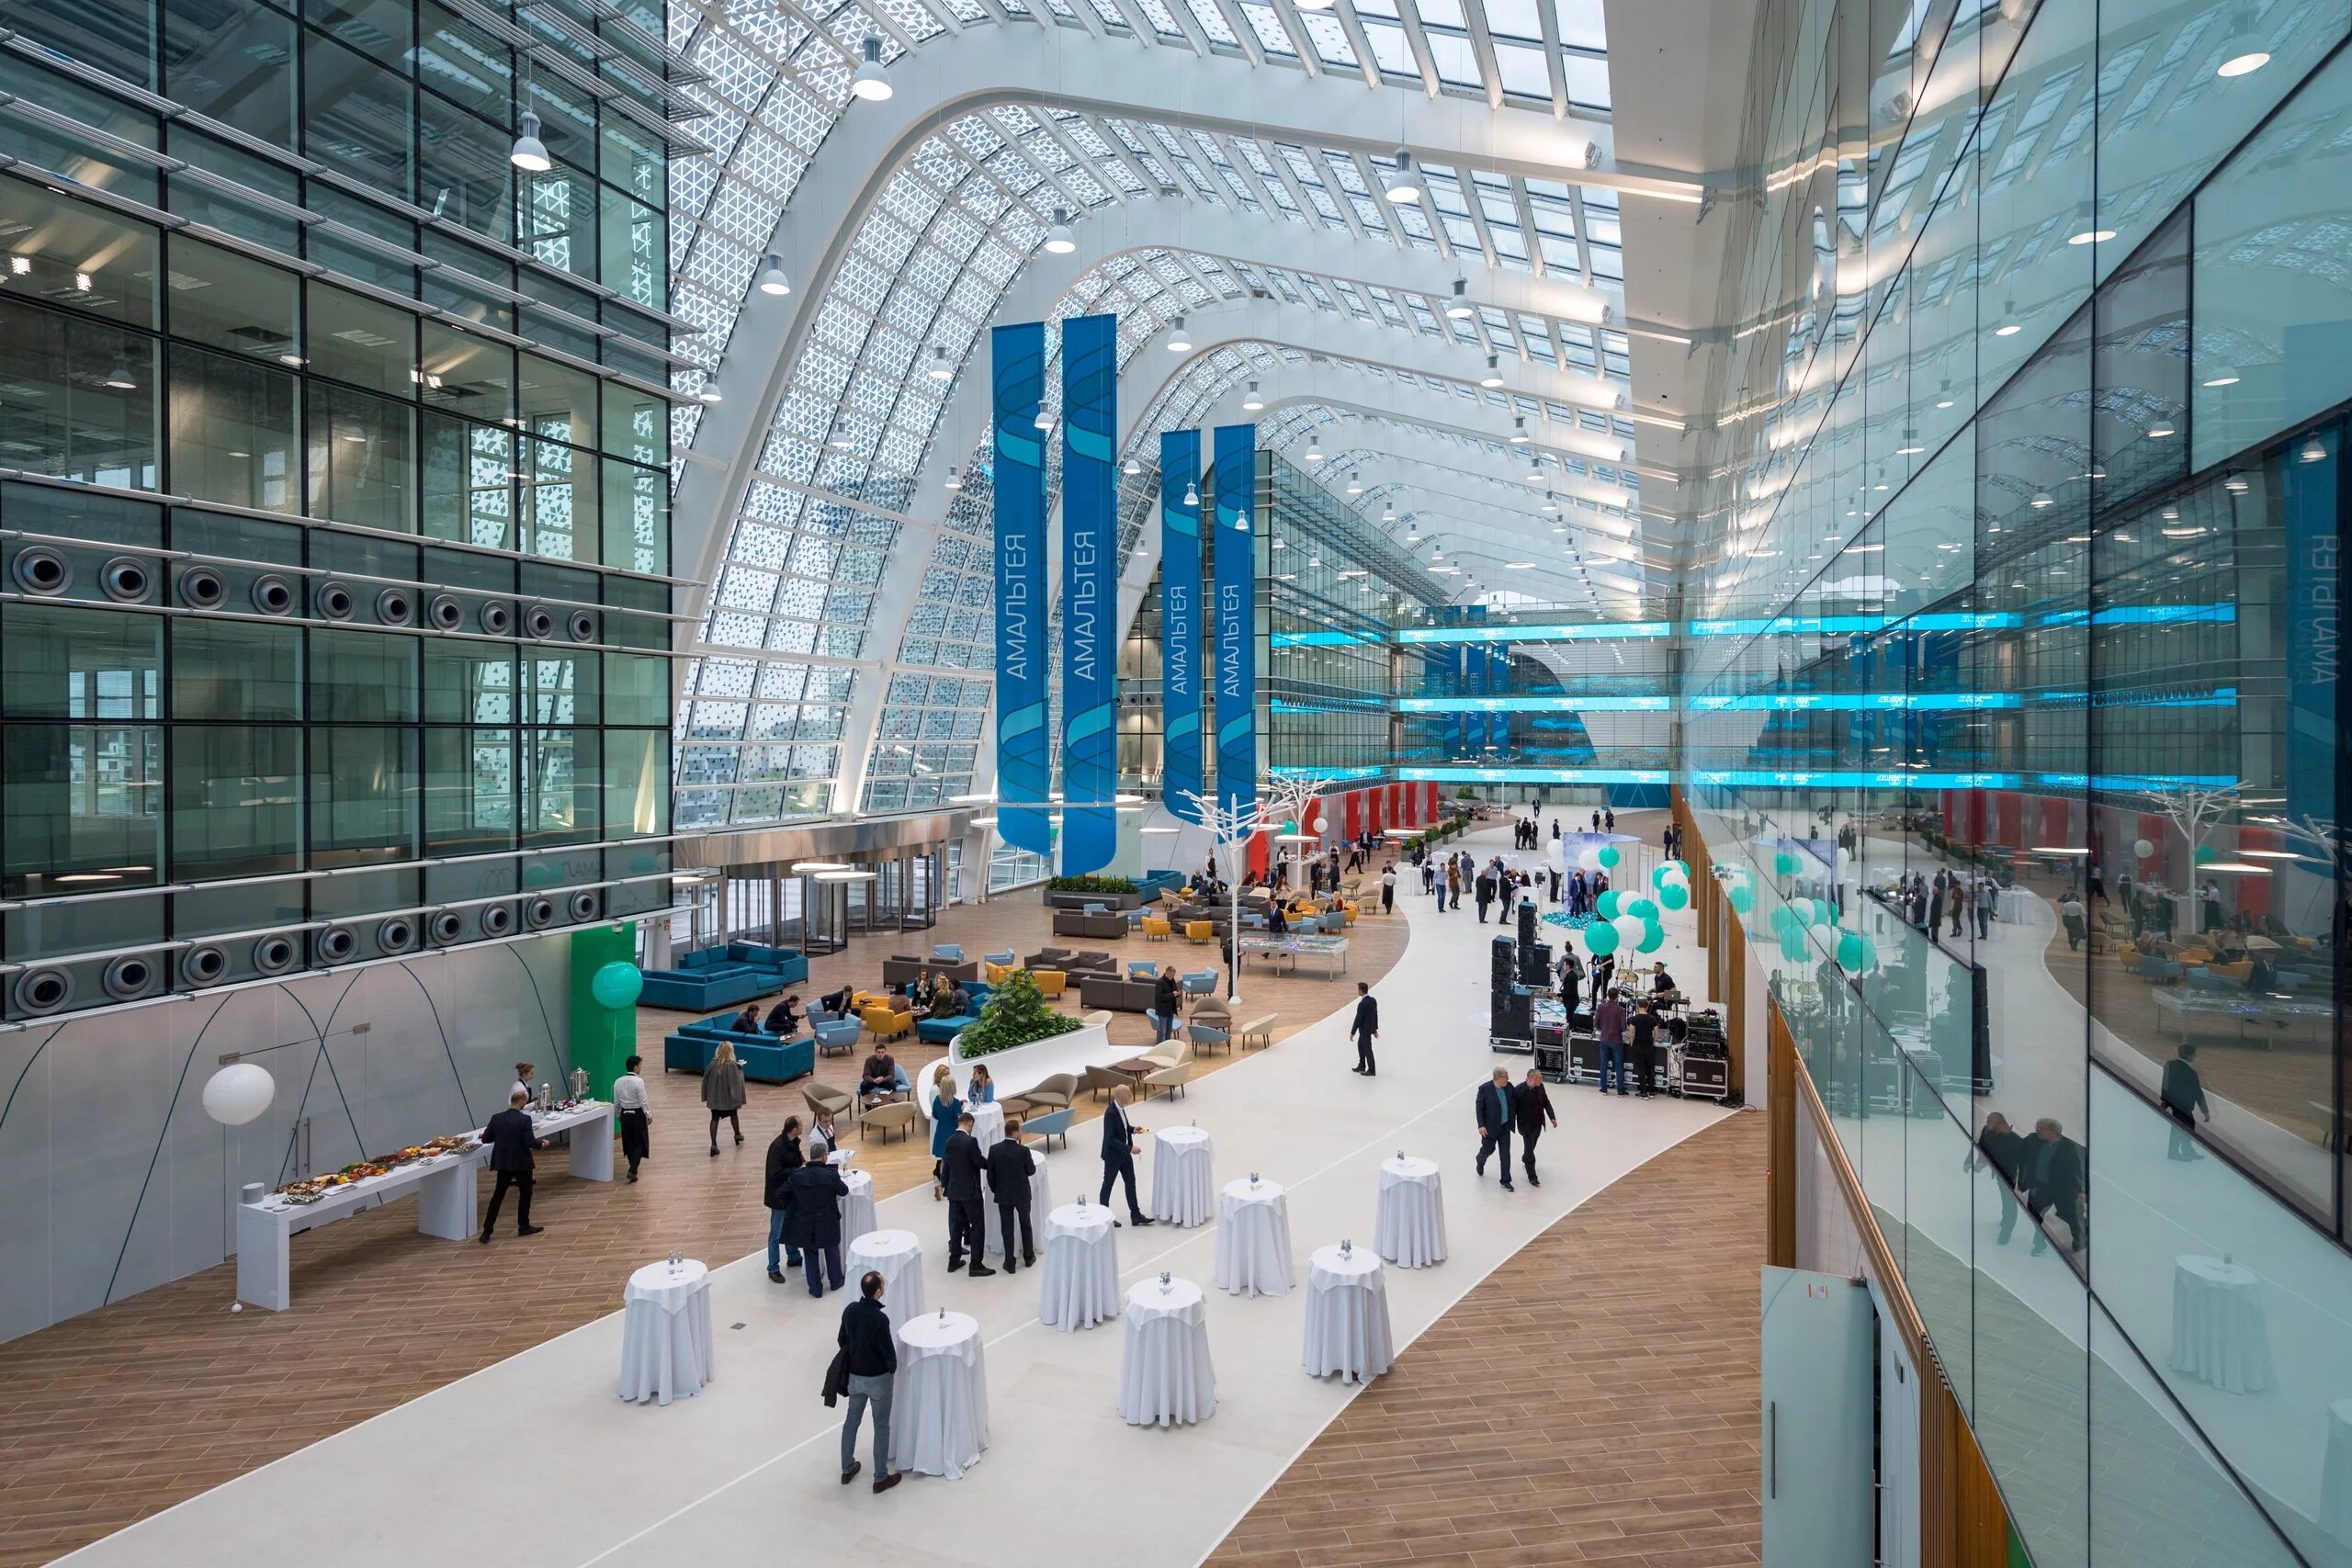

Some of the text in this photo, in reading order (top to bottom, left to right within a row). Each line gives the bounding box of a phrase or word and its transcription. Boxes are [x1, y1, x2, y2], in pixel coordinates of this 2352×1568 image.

[1005, 535, 1027, 681] АМАЛЬТЕЯ
[1074, 531, 1095, 681] АМАЛЬТЕЯ
[1170, 586, 1187, 695] АМАЛЬТЕЯ
[1223, 584, 1239, 697] АМАЛЬТЕЯ
